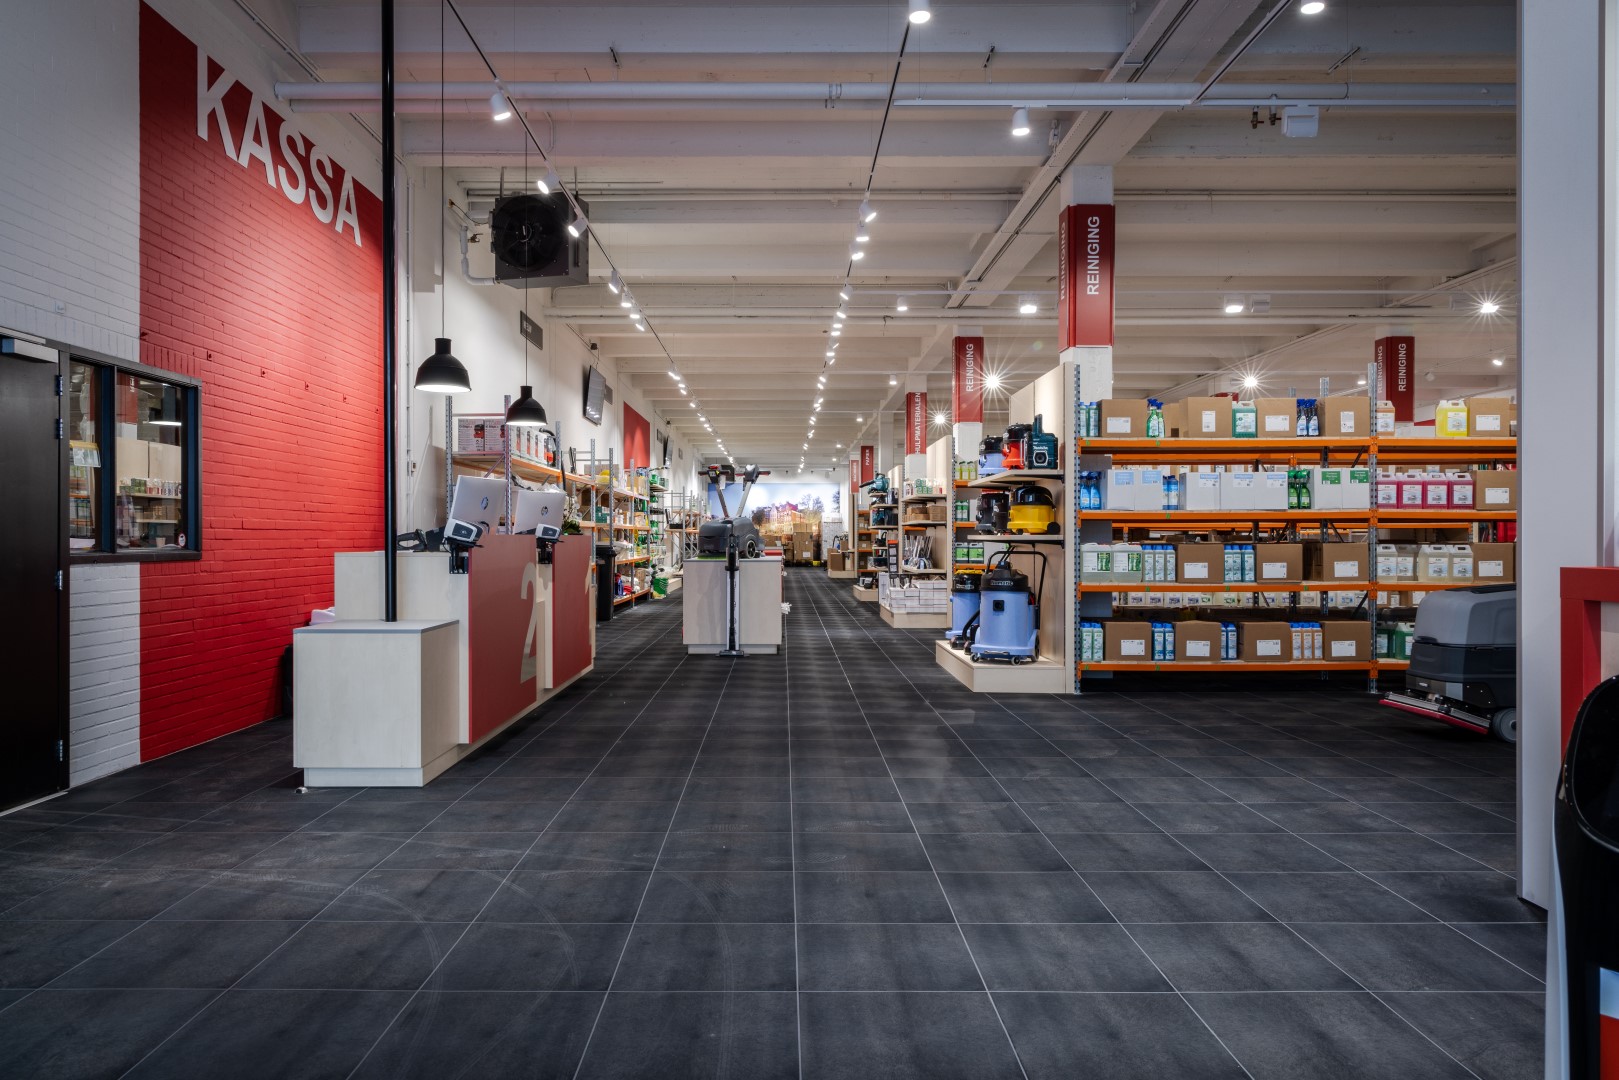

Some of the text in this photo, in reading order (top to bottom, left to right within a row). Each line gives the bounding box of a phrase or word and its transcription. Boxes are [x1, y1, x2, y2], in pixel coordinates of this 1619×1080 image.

[196, 46, 362, 248] KASSA
[1086, 216, 1101, 296] REINIGING
[965, 343, 974, 392] REINIGING
[1398, 343, 1407, 392] REINIGING
[520, 562, 537, 684] 2
